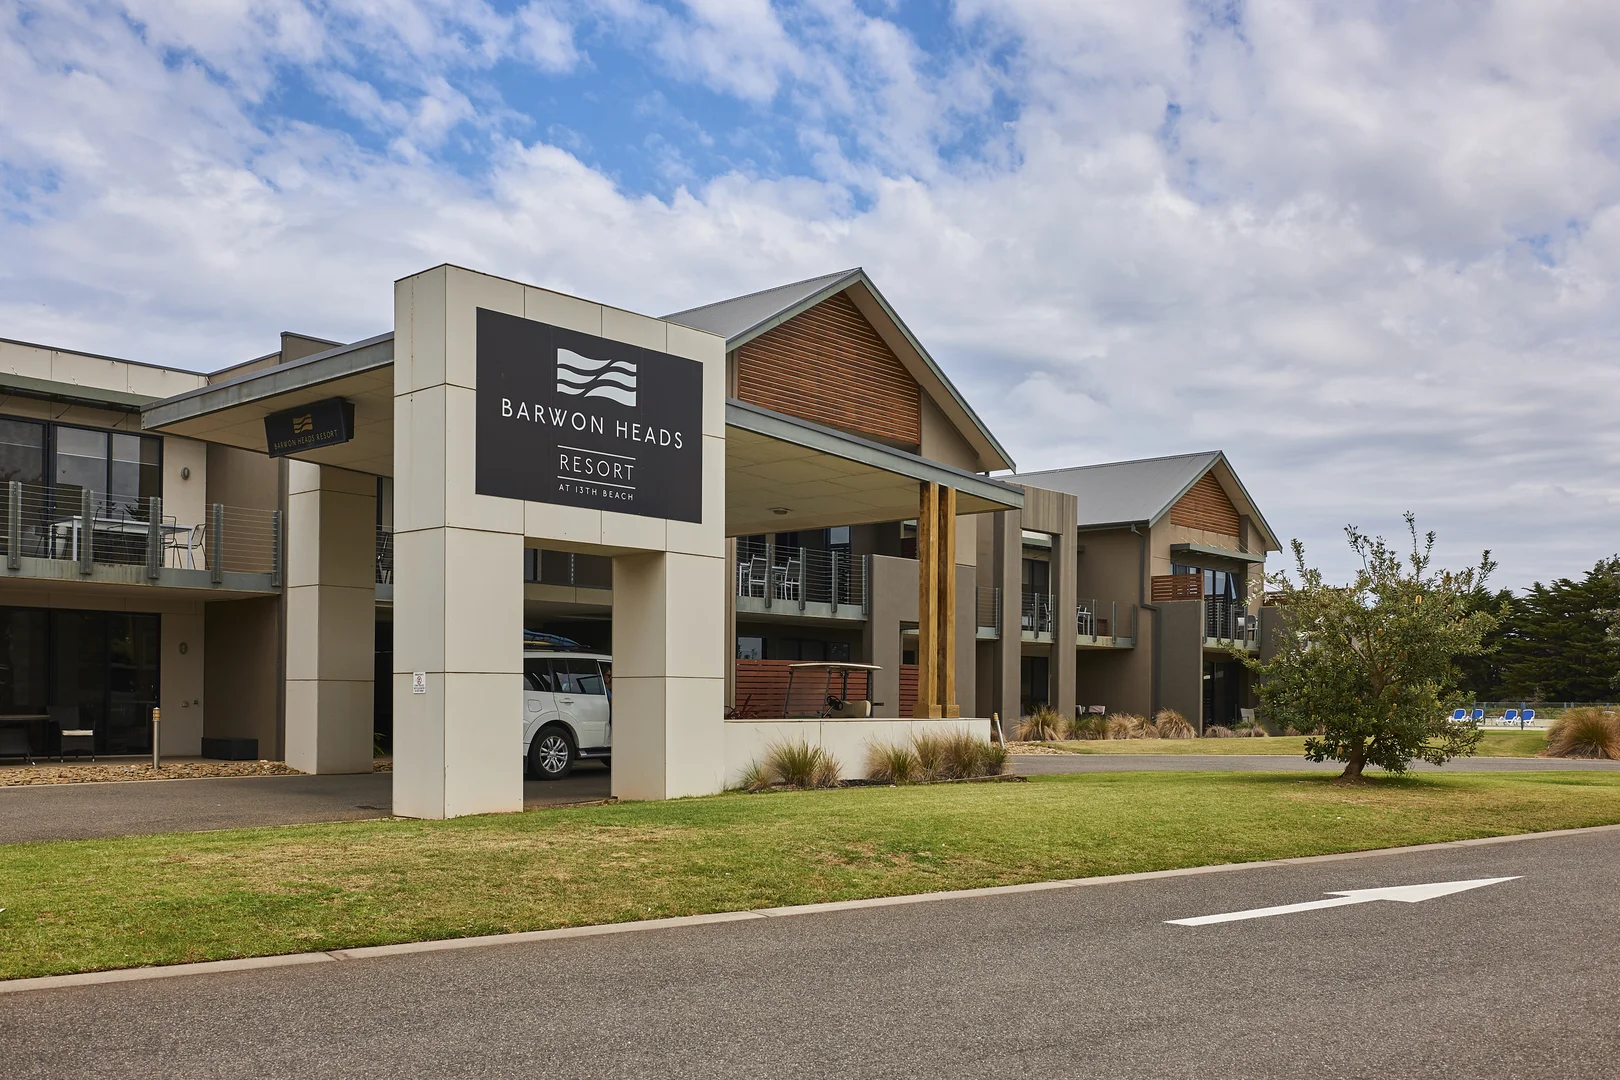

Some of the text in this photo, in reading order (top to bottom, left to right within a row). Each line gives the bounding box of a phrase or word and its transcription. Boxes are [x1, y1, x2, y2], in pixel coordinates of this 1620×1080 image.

[501, 398, 683, 449] BARWON HEADS
[274, 429, 338, 450] BARWON HEADS RESORT
[560, 454, 635, 481] RESORT
[558, 484, 634, 501] AT 13TH BEACH
